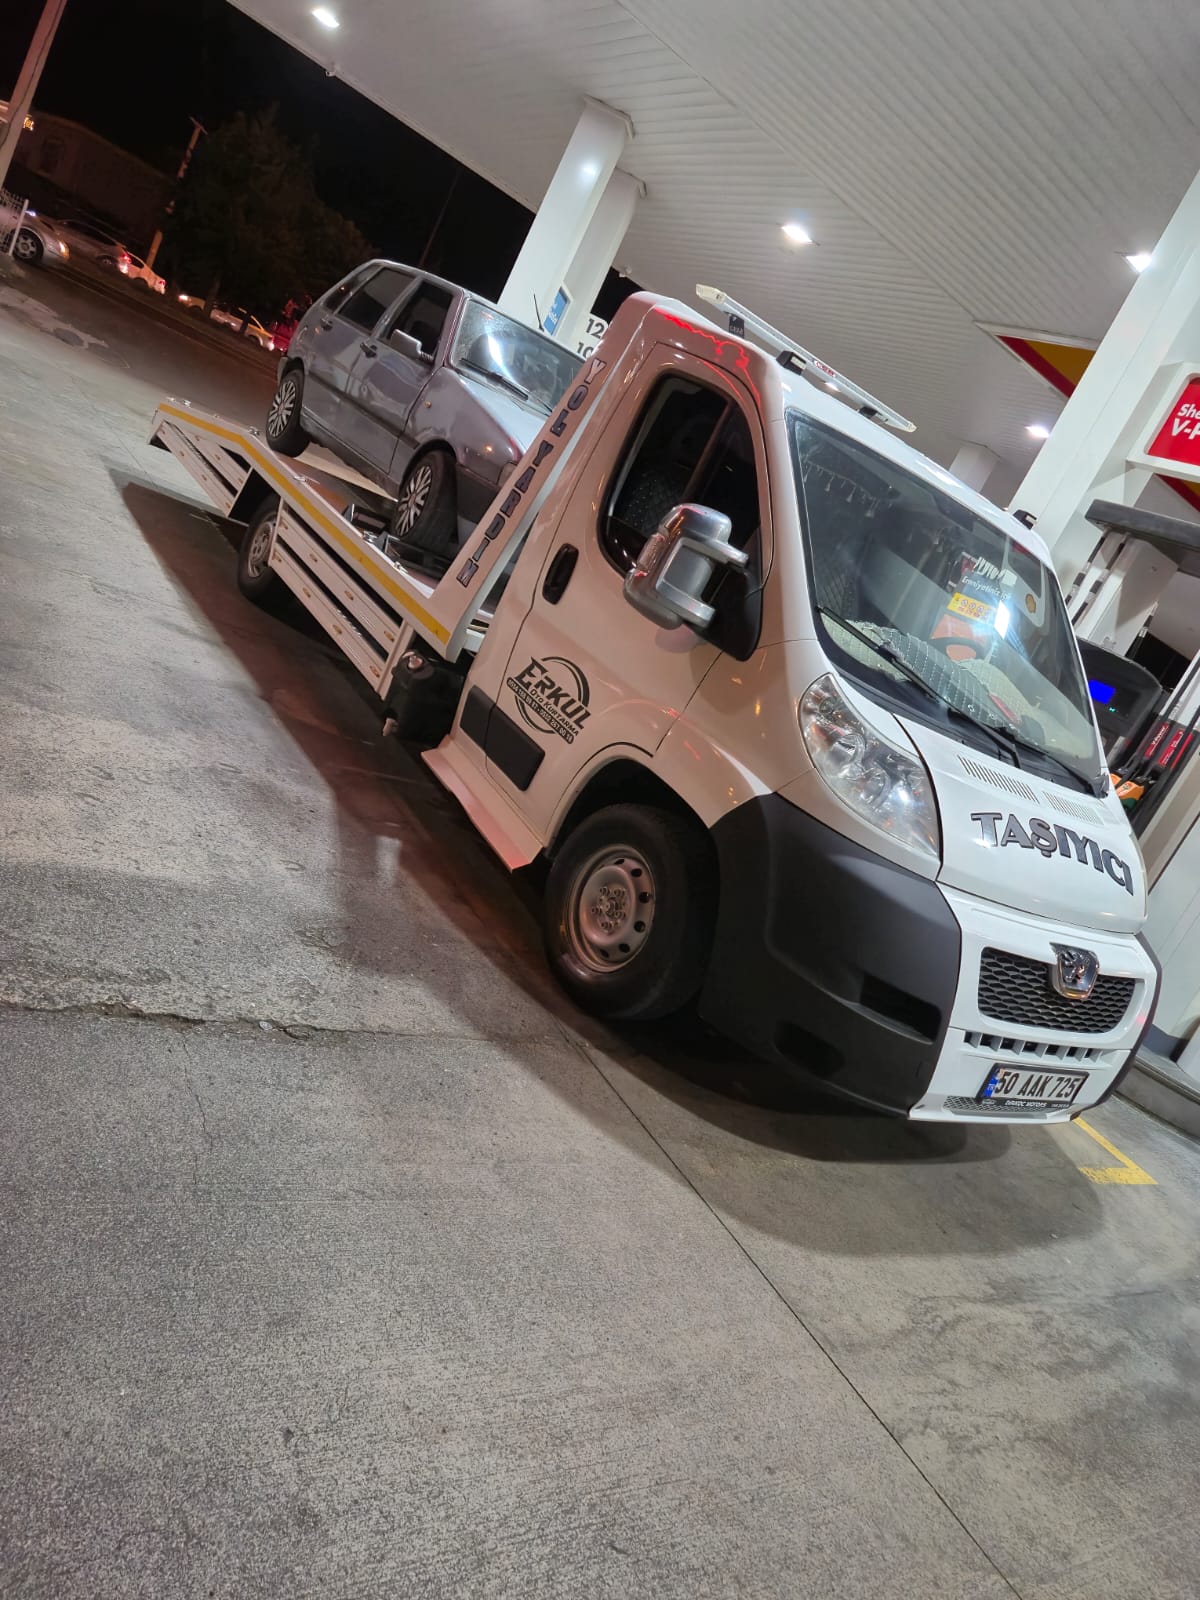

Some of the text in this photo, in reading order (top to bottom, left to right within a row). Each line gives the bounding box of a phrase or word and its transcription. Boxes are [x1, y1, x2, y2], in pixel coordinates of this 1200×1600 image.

[586, 318, 605, 340] 12
[550, 357, 607, 437] YOL
[513, 656, 591, 730] ERKUL
[970, 812, 1134, 896] TAŞIYICI
[994, 1071, 1081, 1098] 50 AAK 725
